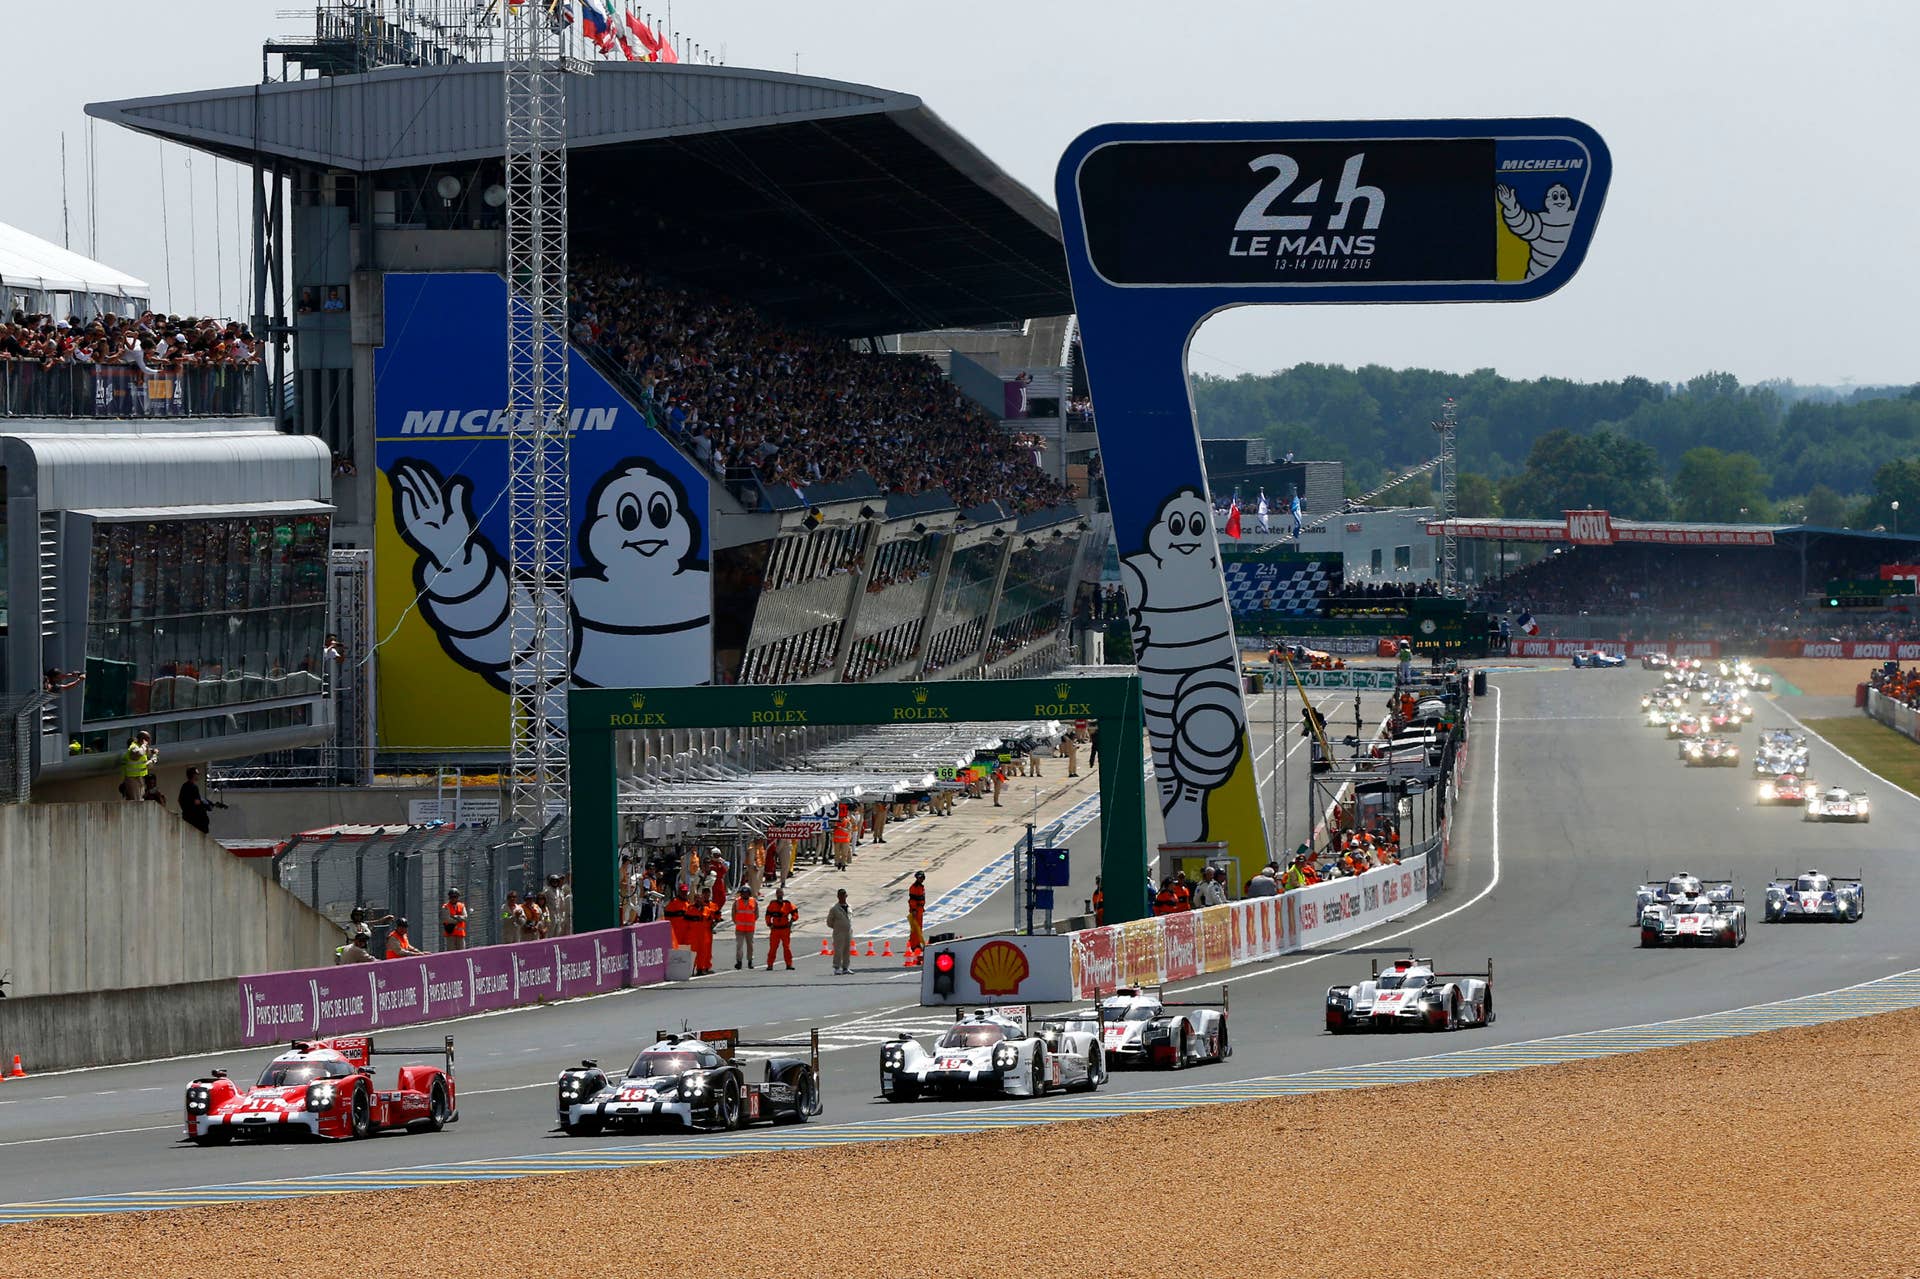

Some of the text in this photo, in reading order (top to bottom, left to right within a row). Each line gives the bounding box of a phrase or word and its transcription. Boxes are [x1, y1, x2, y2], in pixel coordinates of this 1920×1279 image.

[1501, 159, 1583, 169] MICHELIN
[1234, 153, 1385, 230] 24h
[1229, 235, 1376, 256] LE MANS
[1275, 258, 1371, 270] 13-14 JUIN 2015
[400, 408, 618, 433] MICHELIN
[1570, 515, 1609, 539] MOTUL
[1803, 644, 1843, 657] MOTUL
[1853, 644, 1890, 657] MOTUL
[893, 707, 949, 719] ROLEX
[1034, 704, 1091, 715] ROLEX
[610, 713, 667, 725] ROLEX
[752, 710, 808, 722] ROLEX
[941, 768, 953, 777] 66
[798, 828, 810, 837] 23
[257, 1003, 304, 1024] PAYS DE LA LOIRE
[336, 1039, 367, 1048] PORSCHE
[940, 1059, 960, 1069] 19
[620, 1089, 644, 1101] 18
[249, 1098, 273, 1110] 17
[750, 1095, 759, 1115] 18
